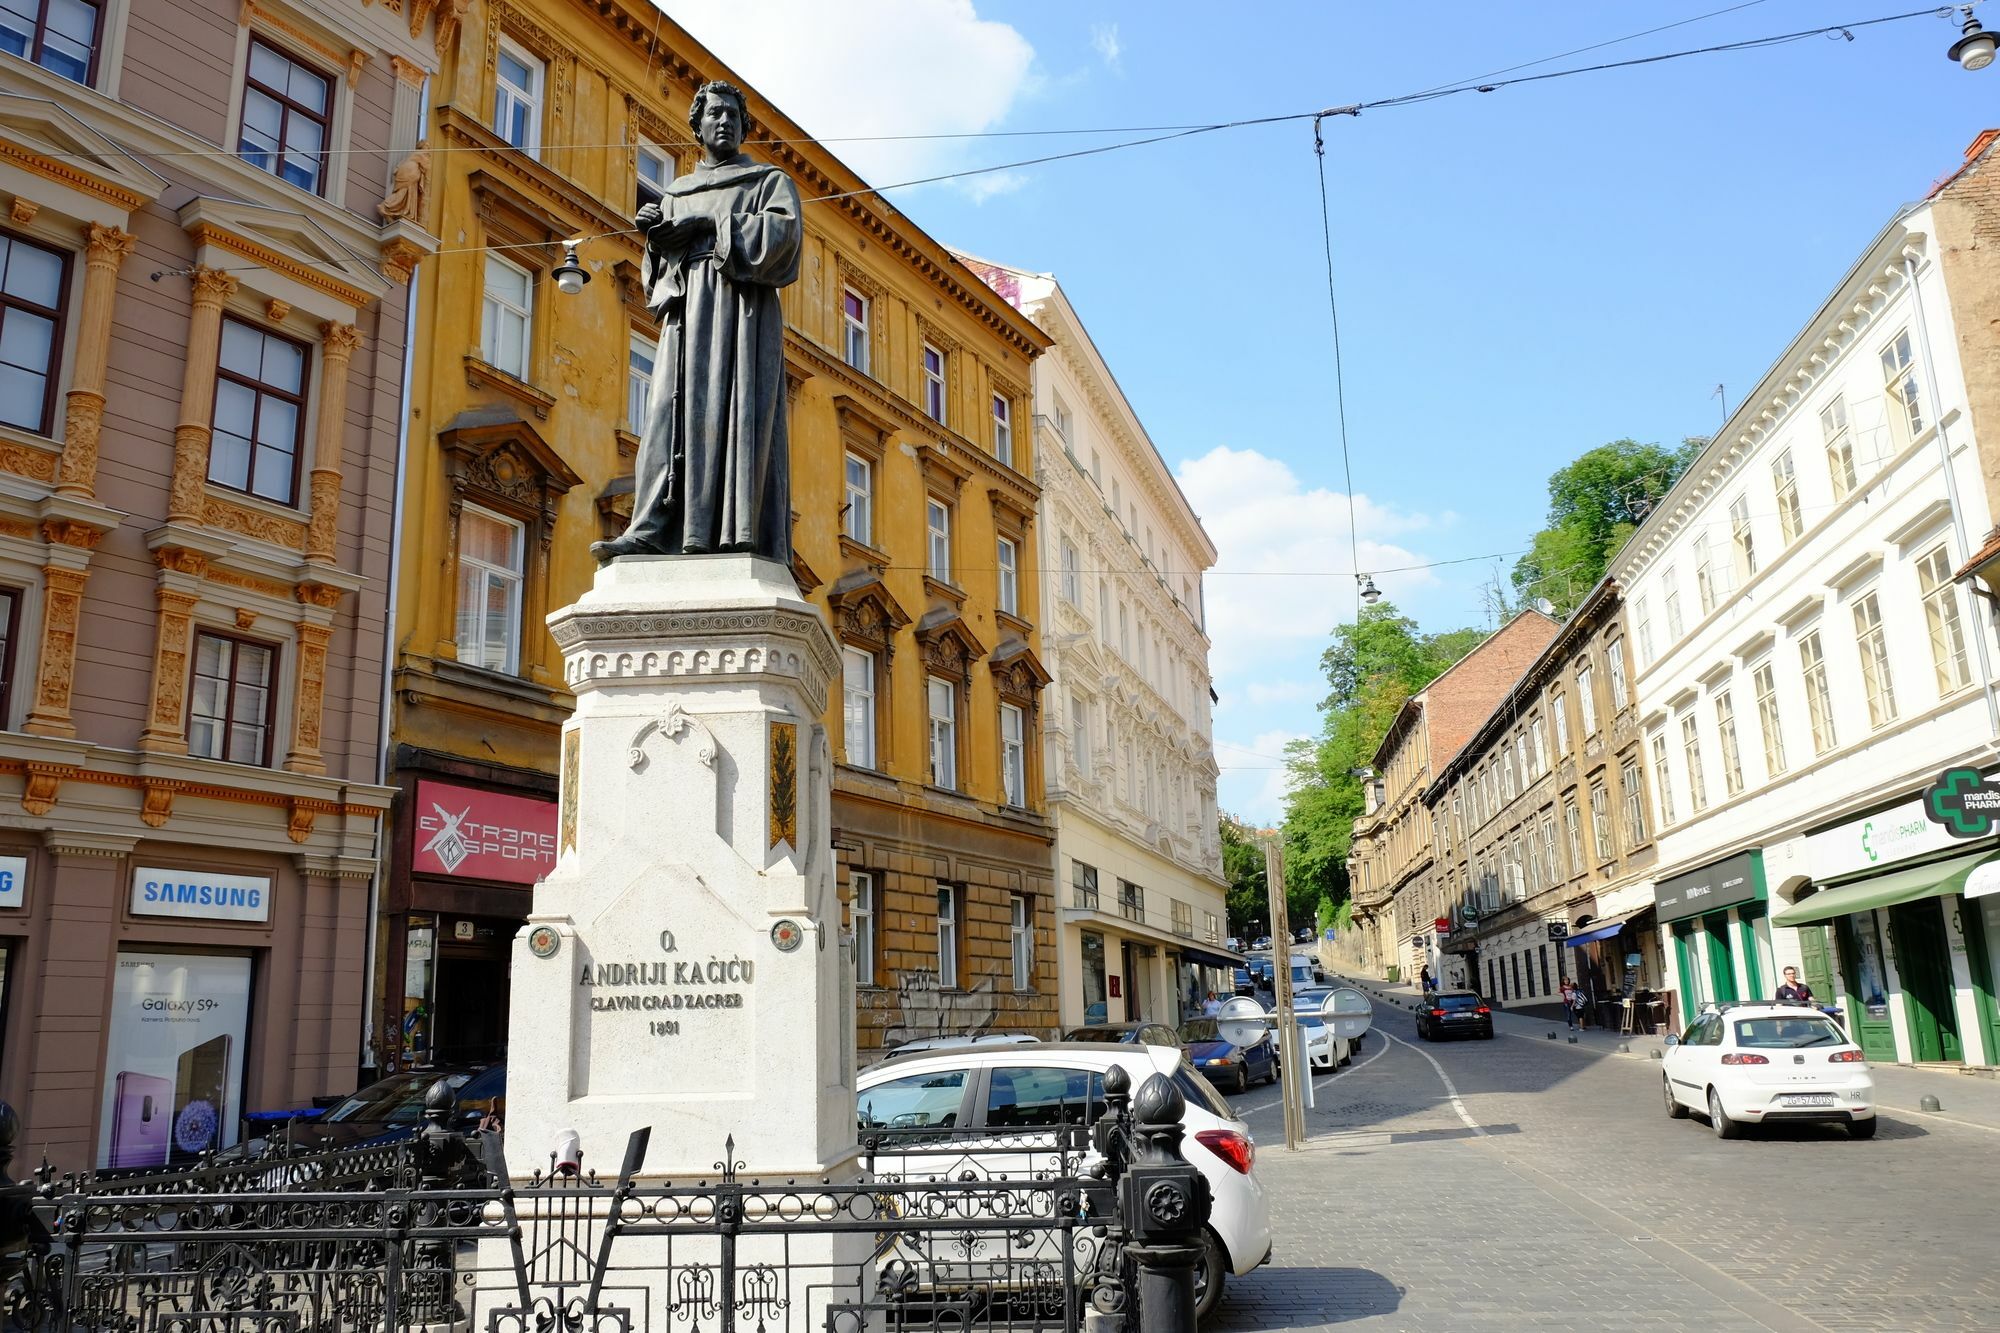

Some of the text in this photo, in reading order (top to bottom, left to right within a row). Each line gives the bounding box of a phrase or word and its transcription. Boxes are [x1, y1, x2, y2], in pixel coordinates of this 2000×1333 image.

[463, 840, 554, 863] SPORT
[144, 881, 261, 908] SAMSUNG
[461, 922, 469, 934] 3
[579, 962, 668, 987] ANDRIJI
[142, 998, 220, 1013] Galaxy S9+
[649, 1021, 680, 1036] 1891
[1850, 1091, 1861, 1100] HR
